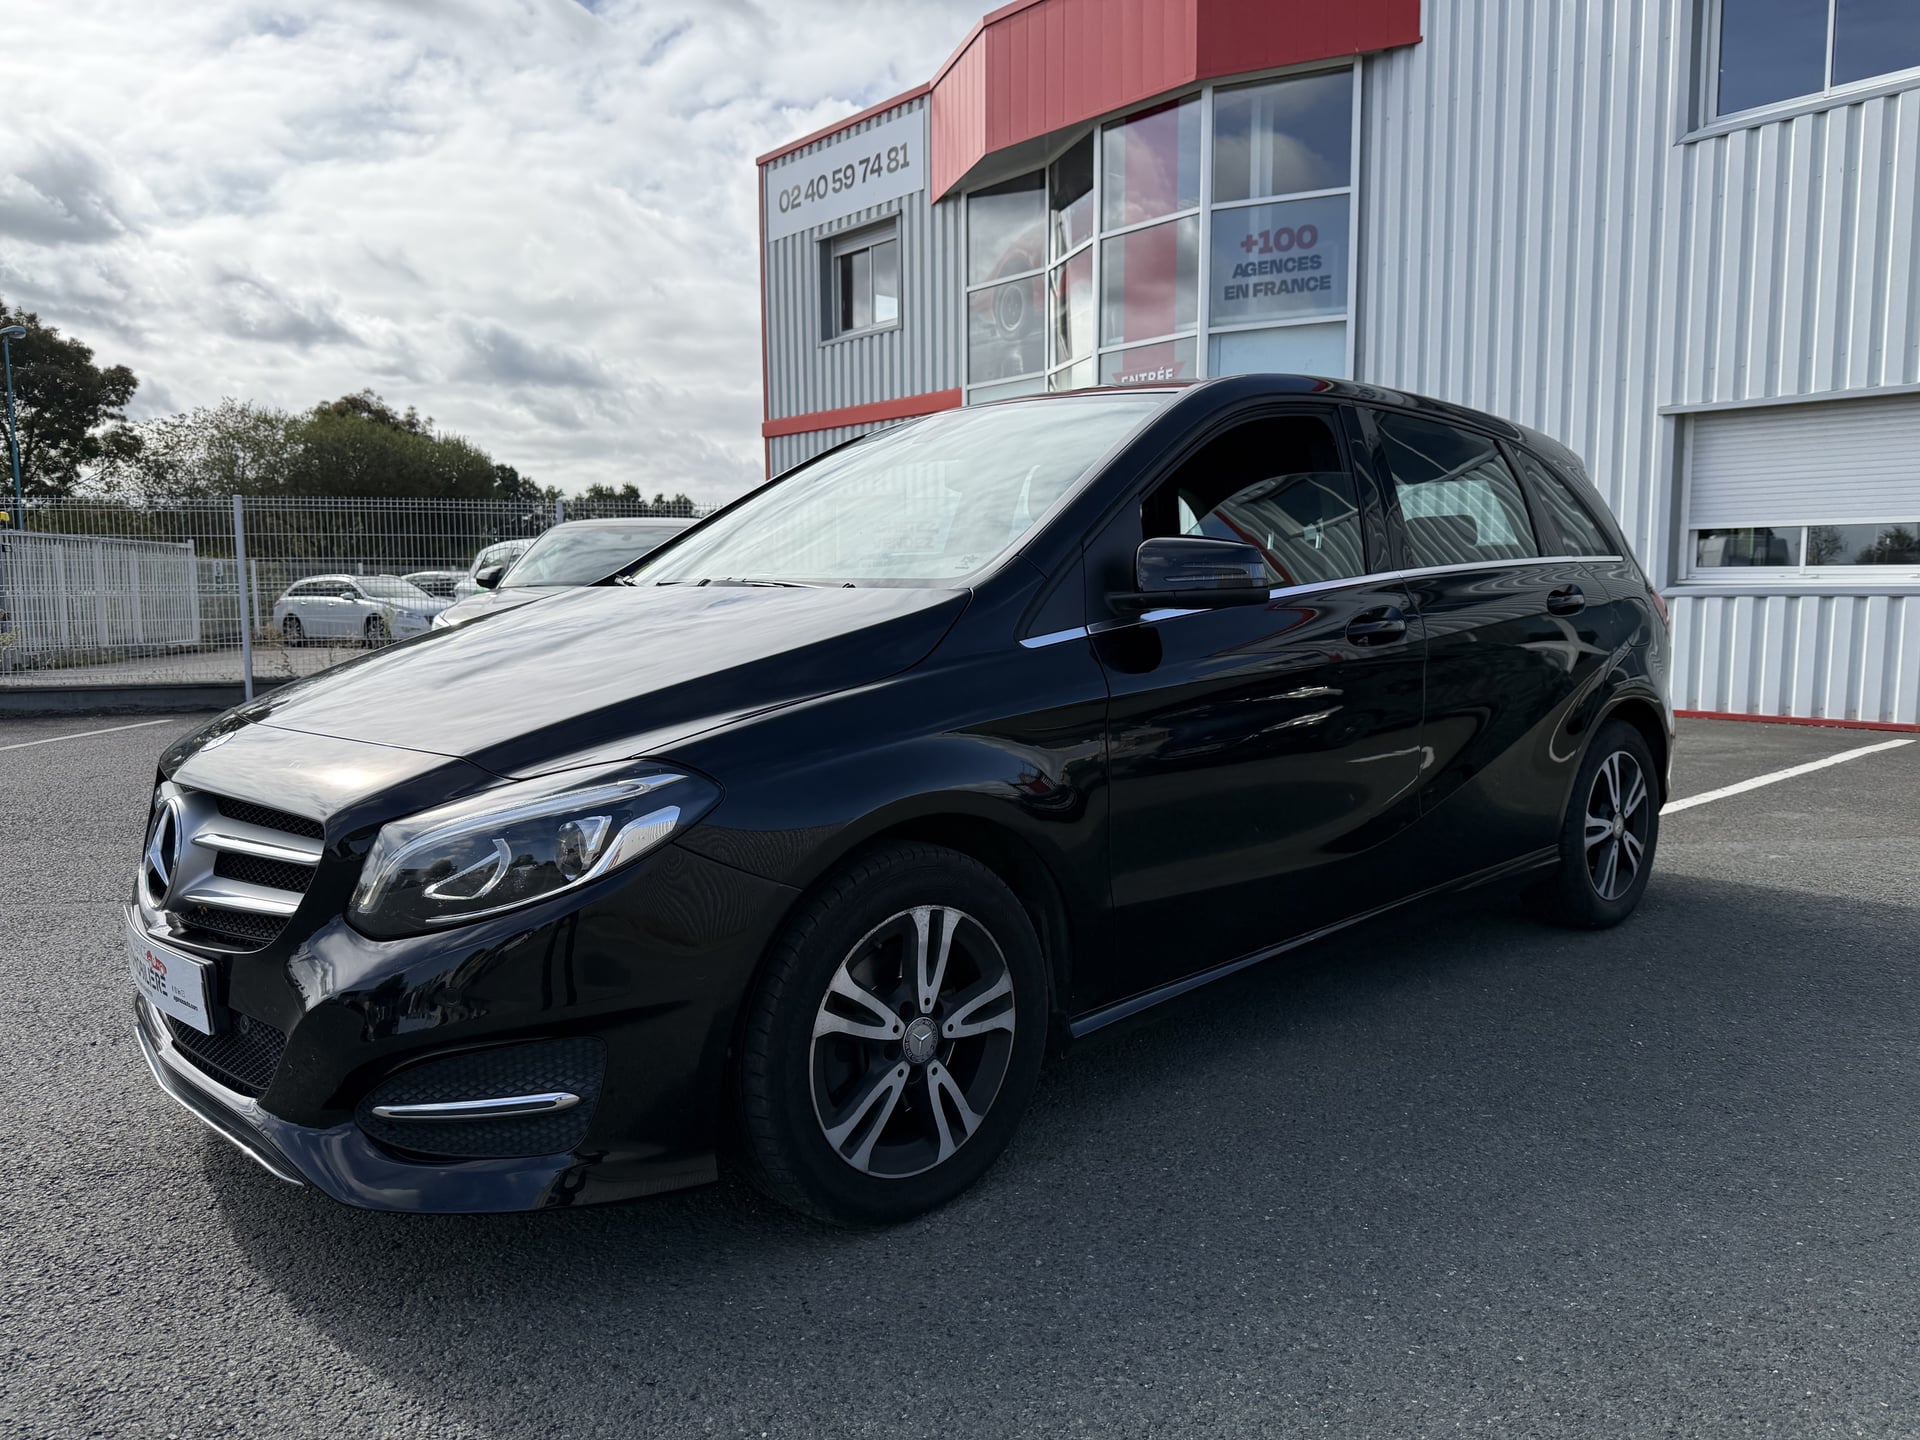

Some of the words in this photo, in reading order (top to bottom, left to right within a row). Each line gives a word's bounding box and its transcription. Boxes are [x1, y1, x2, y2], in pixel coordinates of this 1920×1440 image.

[779, 185, 802, 214] 02
[804, 175, 828, 202] 40
[831, 164, 855, 193] 59
[858, 153, 883, 183] 74
[887, 142, 910, 174] 81
[1240, 224, 1319, 254] +100
[1231, 254, 1322, 279] AGENCES
[1223, 283, 1249, 301] EN
[1252, 275, 1332, 298] FRANCE
